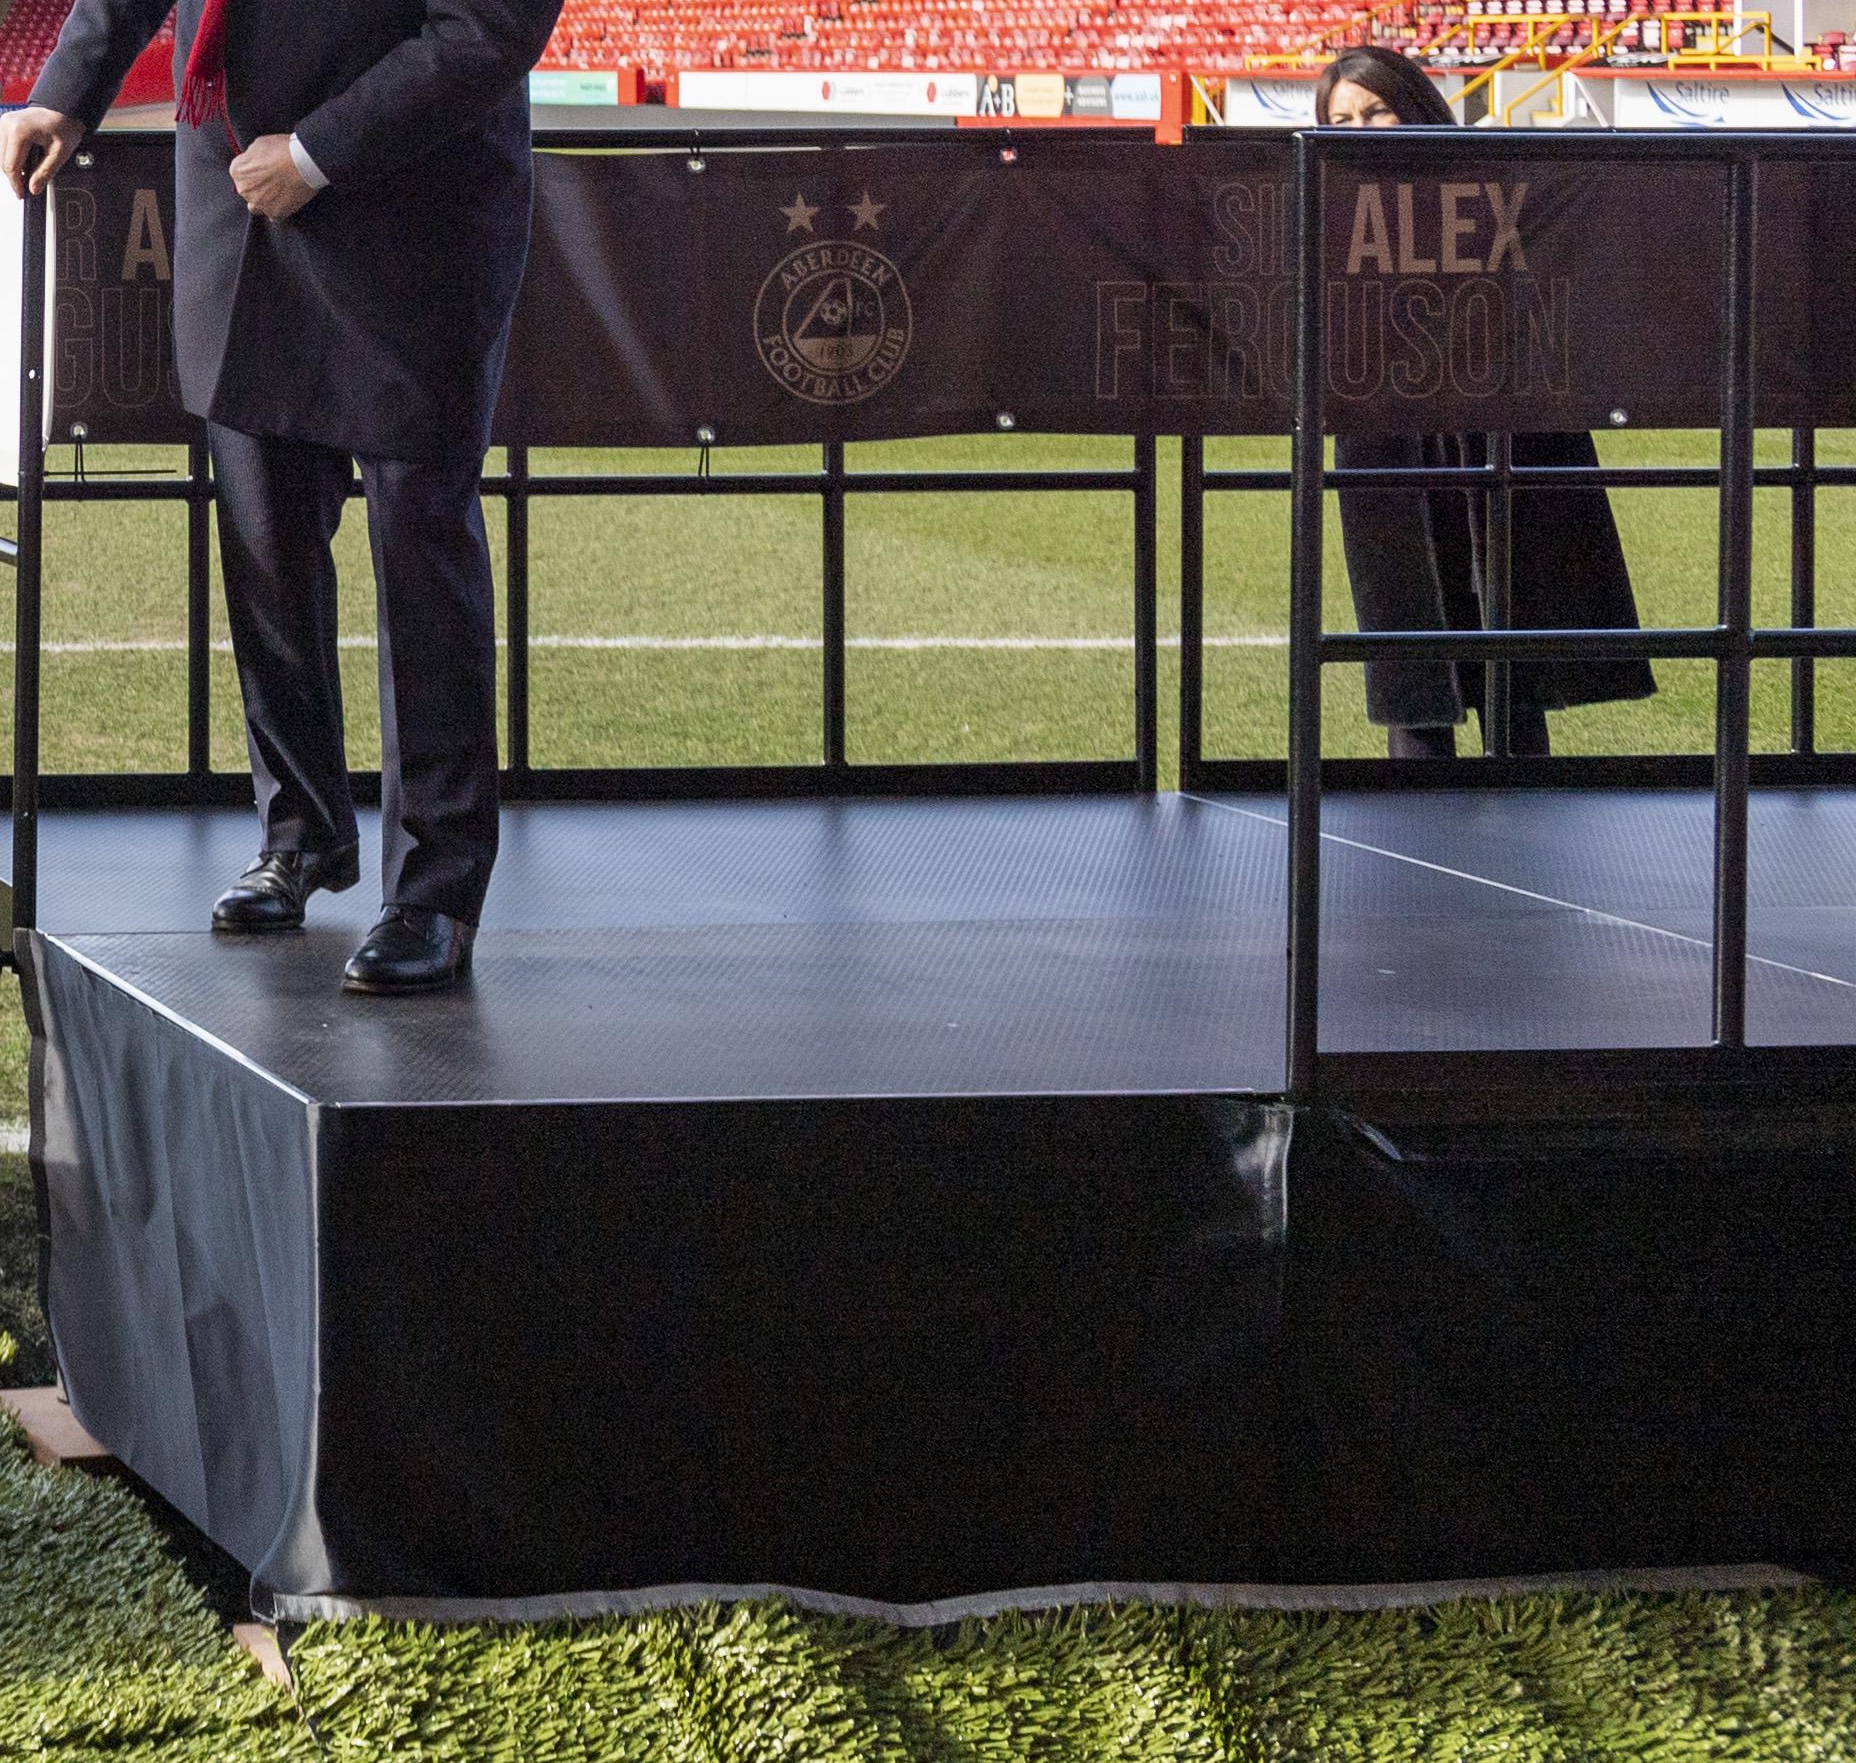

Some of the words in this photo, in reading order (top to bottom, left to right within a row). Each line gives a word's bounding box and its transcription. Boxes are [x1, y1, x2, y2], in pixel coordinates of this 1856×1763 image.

[1676, 81, 1729, 105] Saltire
[1813, 82, 1856, 106] Salti
[1347, 182, 1529, 274] ALEX
[781, 249, 894, 289] ABERDEEN
[762, 335, 868, 396] FOOTBALL
[868, 328, 905, 381] CLUB
